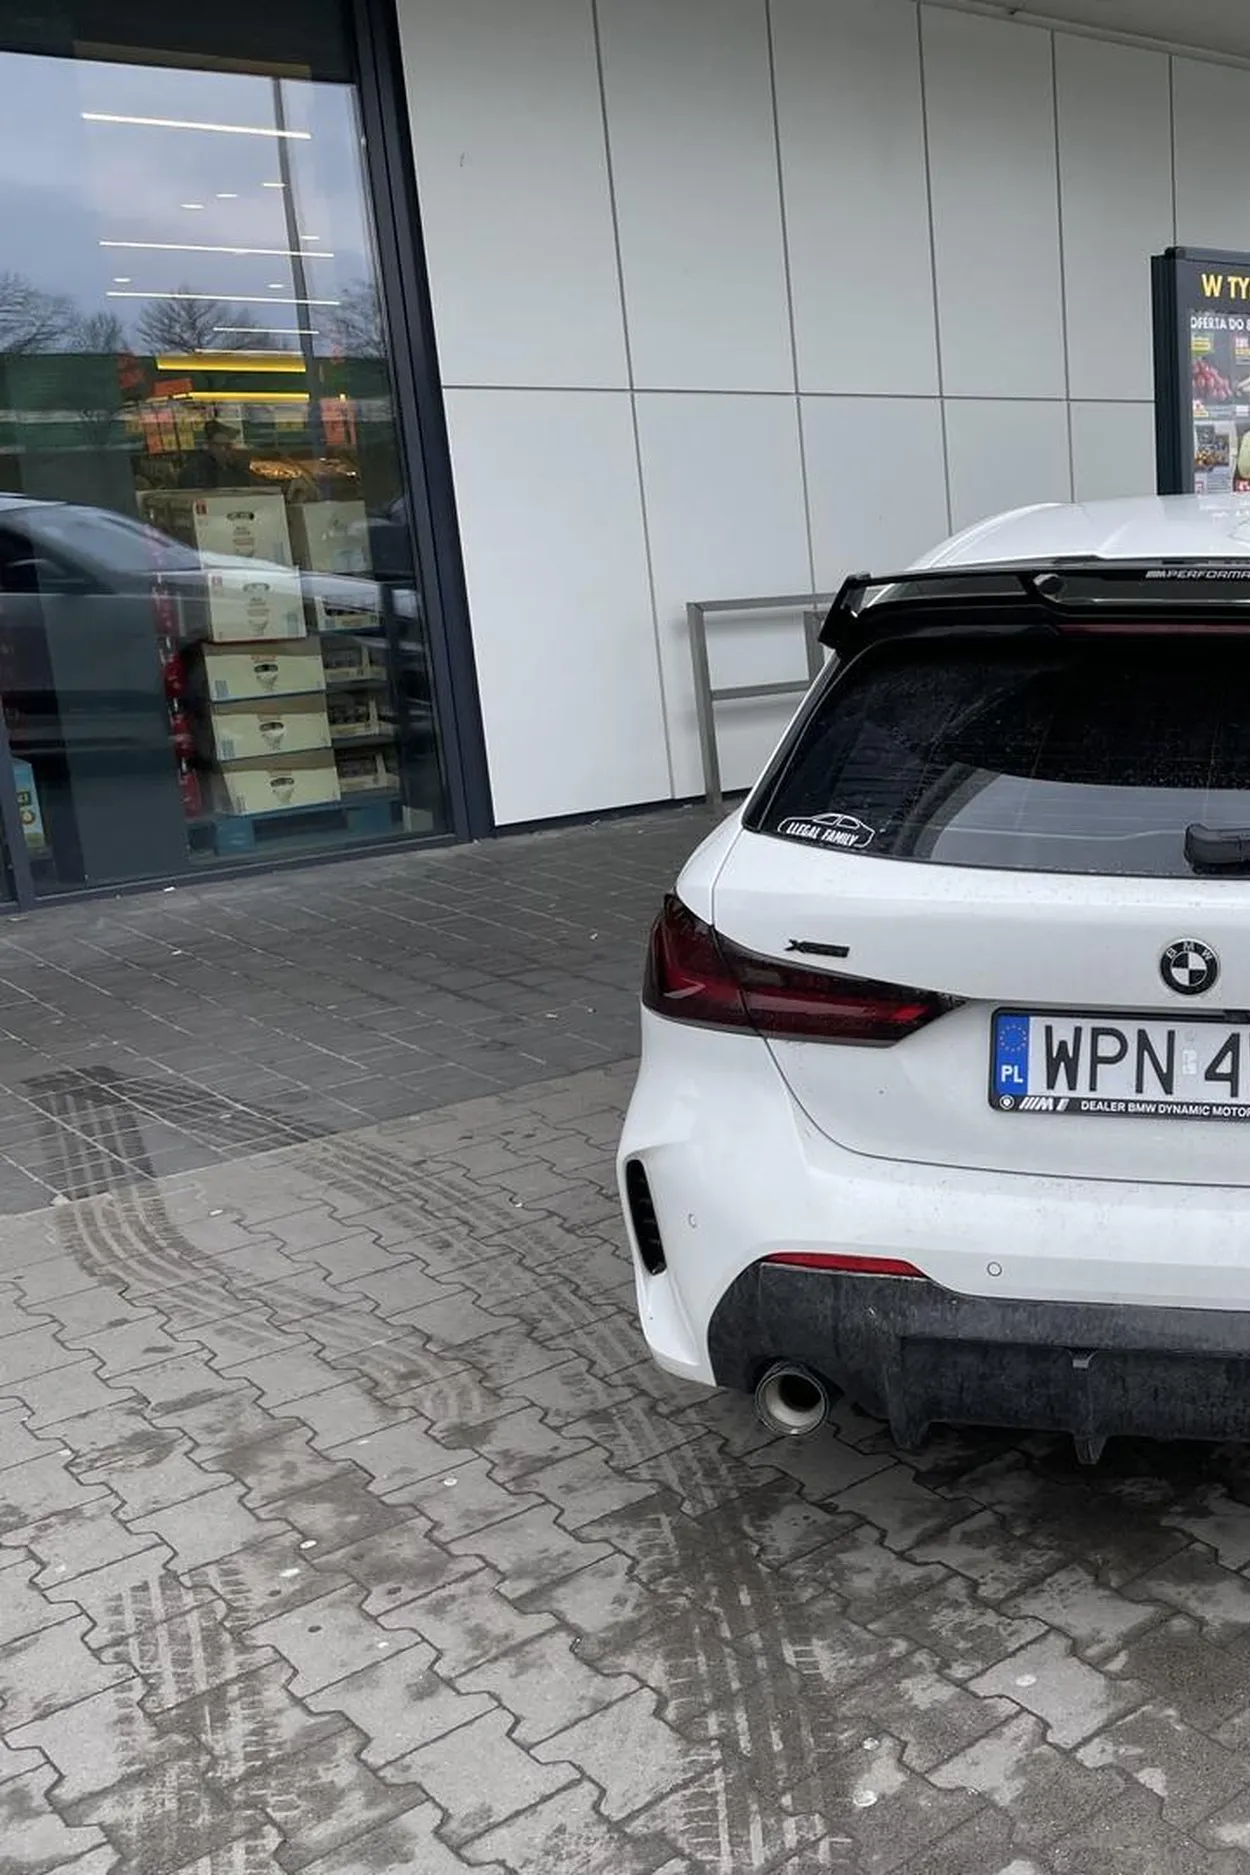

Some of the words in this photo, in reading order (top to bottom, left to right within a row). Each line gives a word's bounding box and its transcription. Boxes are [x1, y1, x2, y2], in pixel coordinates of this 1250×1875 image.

[1201, 273, 1223, 298] W
[1228, 318, 1245, 331] DO
[820, 829, 858, 845] FAMILY
[1166, 941, 1213, 960] BMW
[1044, 1024, 1176, 1096] WPN
[1000, 1064, 1023, 1083] PL
[1080, 1100, 1126, 1112] DEALER
[1128, 1101, 1157, 1113] BMW
[1158, 1103, 1211, 1116] DYNAMIC
